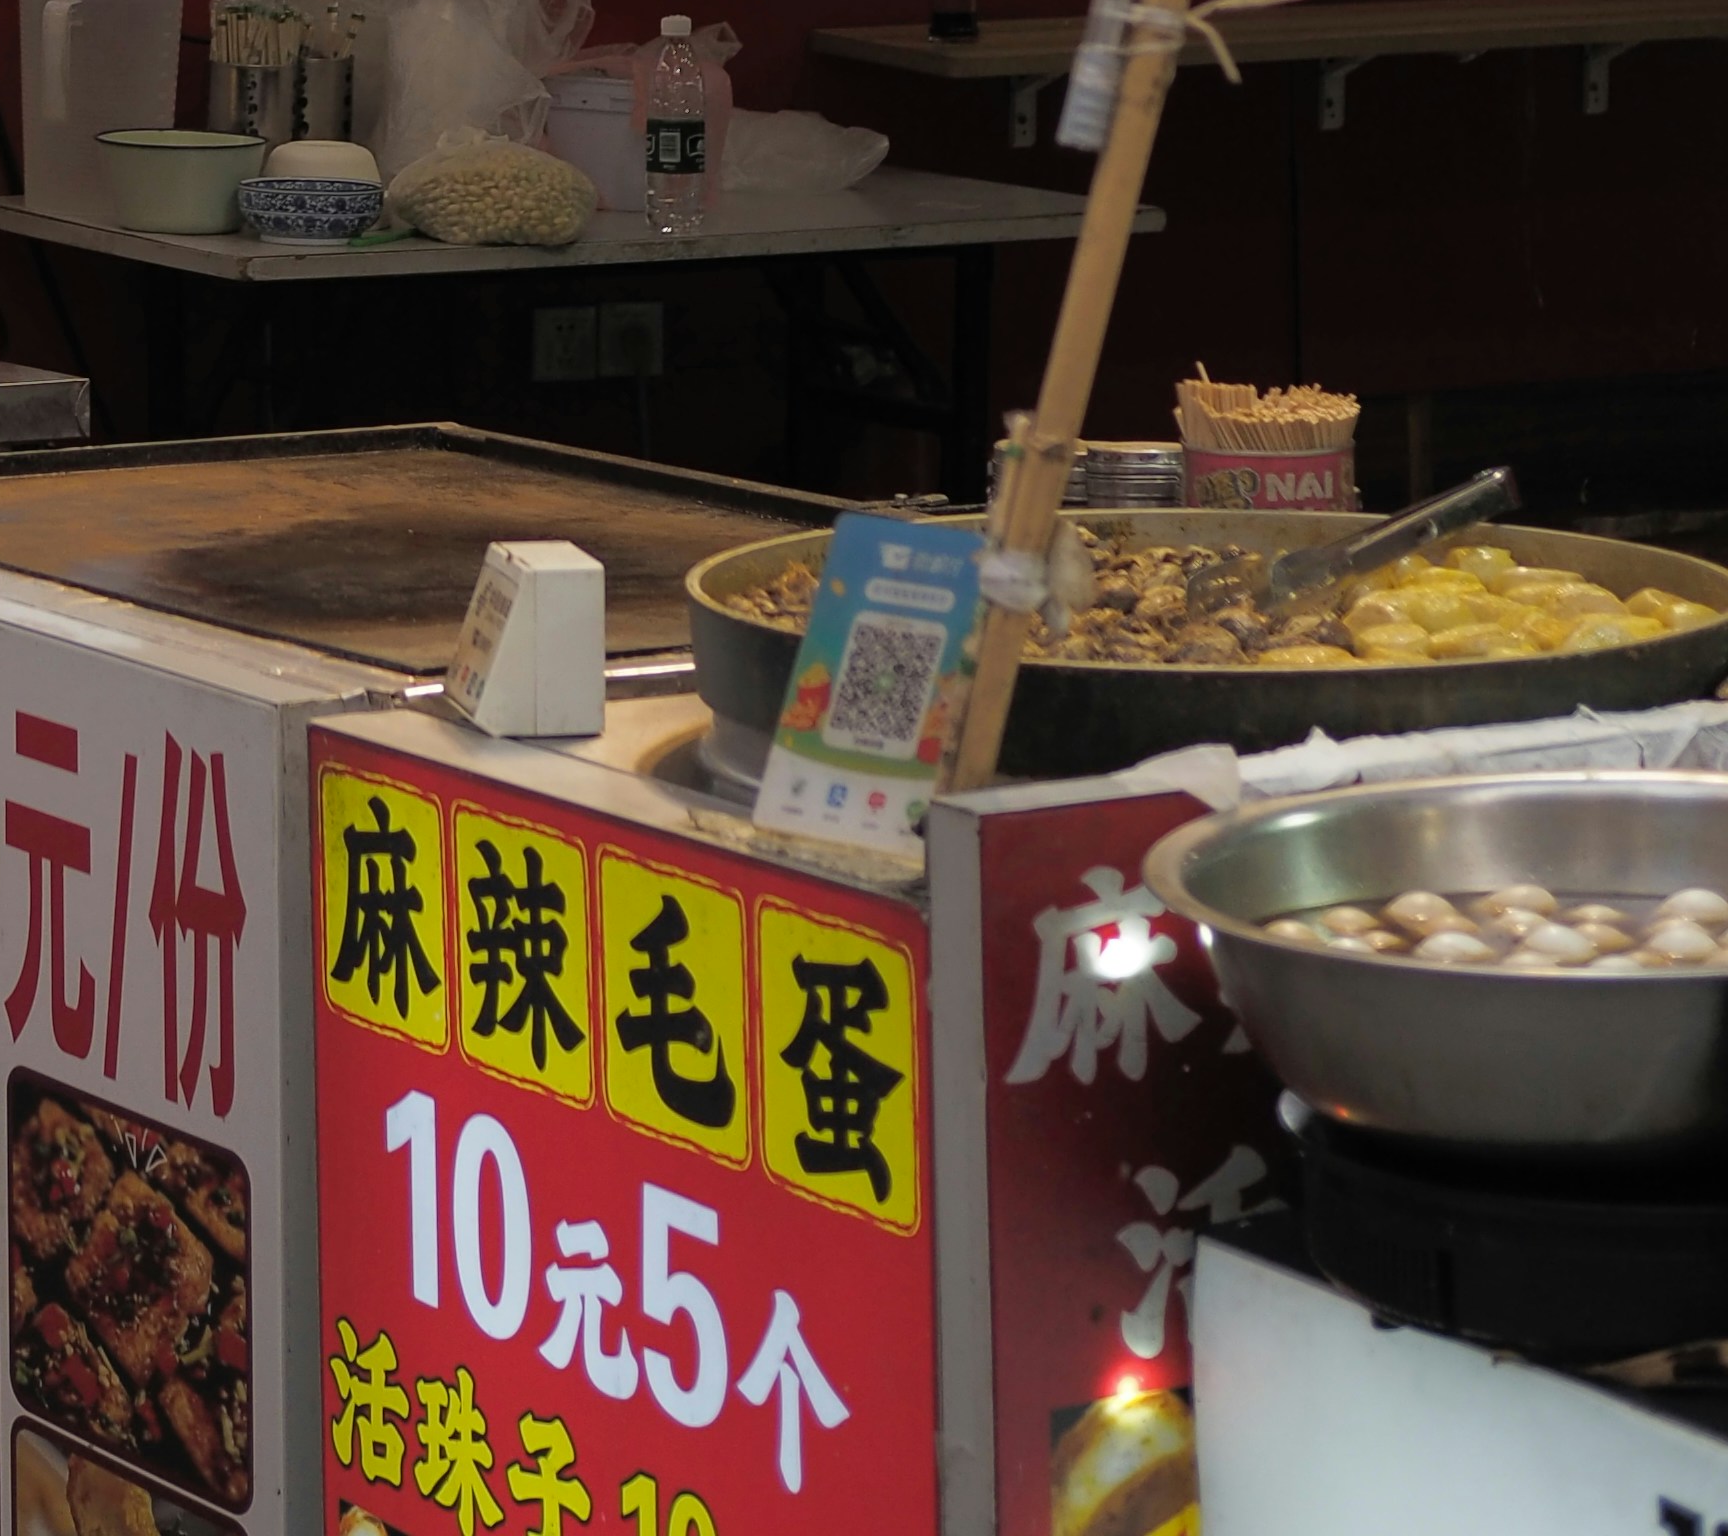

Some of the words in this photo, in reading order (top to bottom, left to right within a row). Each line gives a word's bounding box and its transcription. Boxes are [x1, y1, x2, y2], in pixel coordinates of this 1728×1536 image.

[330, 795, 906, 1206] 麻辣毛蛋
[329, 1318, 593, 1536] 活珠子
[384, 1088, 852, 1494] 10元5个
